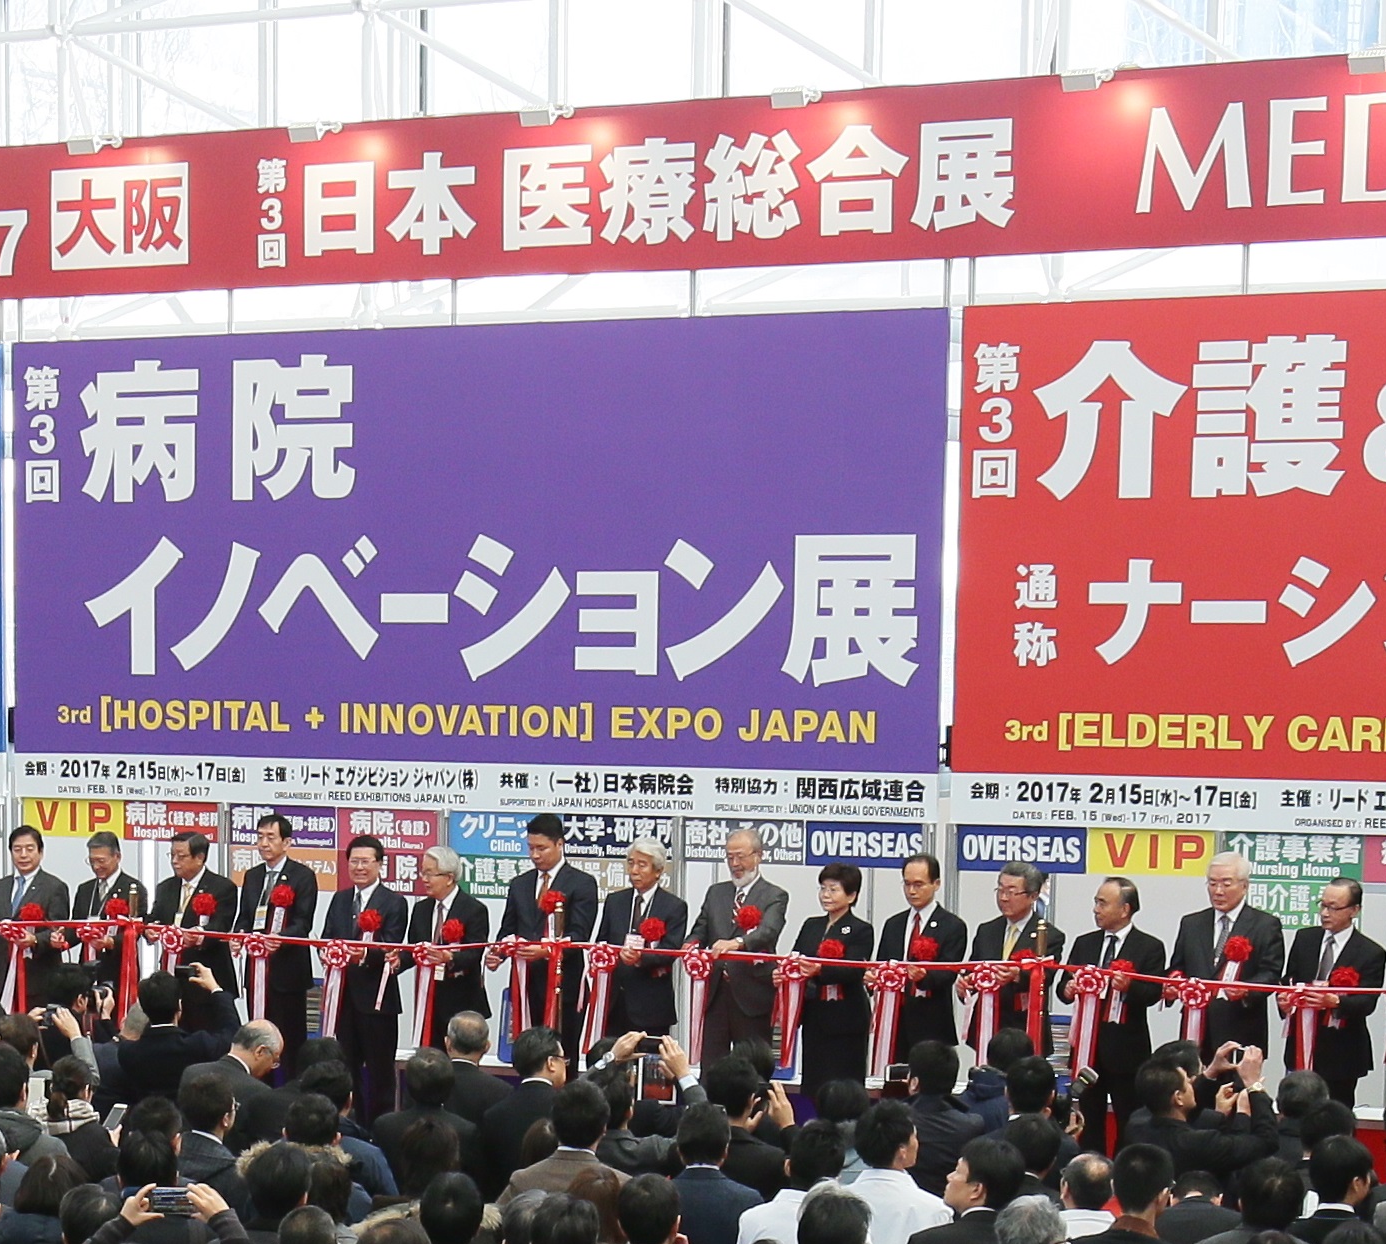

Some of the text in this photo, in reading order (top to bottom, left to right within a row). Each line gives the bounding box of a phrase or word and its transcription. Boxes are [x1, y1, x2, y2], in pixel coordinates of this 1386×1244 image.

[303, 118, 1015, 256] 日本 医療総合展
[55, 176, 184, 257] 大阪
[256, 158, 286, 269] 第3回
[23, 366, 60, 503] 第3回
[79, 354, 357, 503] 病院
[971, 341, 1022, 500] 第3回
[85, 534, 919, 688] イノベーション展
[1013, 563, 1057, 669] 通称
[57, 696, 876, 744] 3rd [HOSPITAL + INNOVATION] EXPO JAPAN
[1004, 718, 1049, 744] 3rd
[1058, 710, 1274, 756] [ELDERLY
[328, 791, 351, 801] REED
[354, 792, 411, 802] EXHIBITIONS
[414, 793, 446, 803] JAPAN
[552, 797, 694, 811] JAPAN HOSPITAL ASSOCIATION
[796, 777, 925, 803] 関西広域連合
[36, 801, 112, 832] VIP
[789, 803, 925, 818] UNION OF KANSAI GOVERNMENTS
[1176, 813, 1211, 825] 2017
[133, 826, 174, 840] Hospital
[490, 839, 521, 852] Clinic
[811, 831, 923, 858] OVERSEAS
[962, 834, 1082, 862] OVERSEAS
[1105, 833, 1206, 870] VIP
[1249, 862, 1341, 878] Nursing Home
